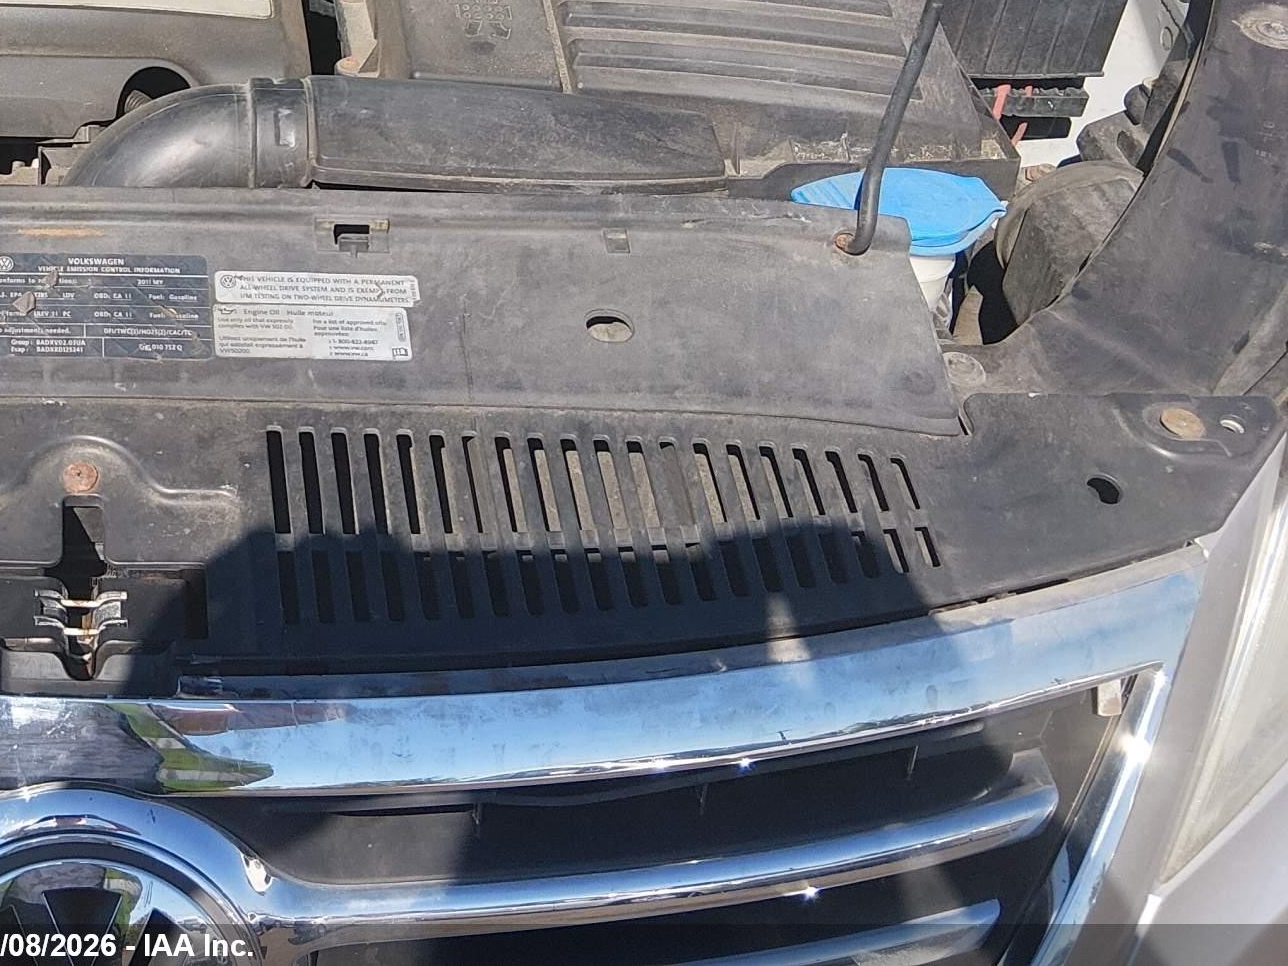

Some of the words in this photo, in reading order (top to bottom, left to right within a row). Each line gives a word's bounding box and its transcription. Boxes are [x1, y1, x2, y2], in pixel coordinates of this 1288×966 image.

[67, 257, 125, 266] VOLKSWAGEN
[101, 266, 132, 274] CONTROL
[133, 266, 181, 275] INFORMATION
